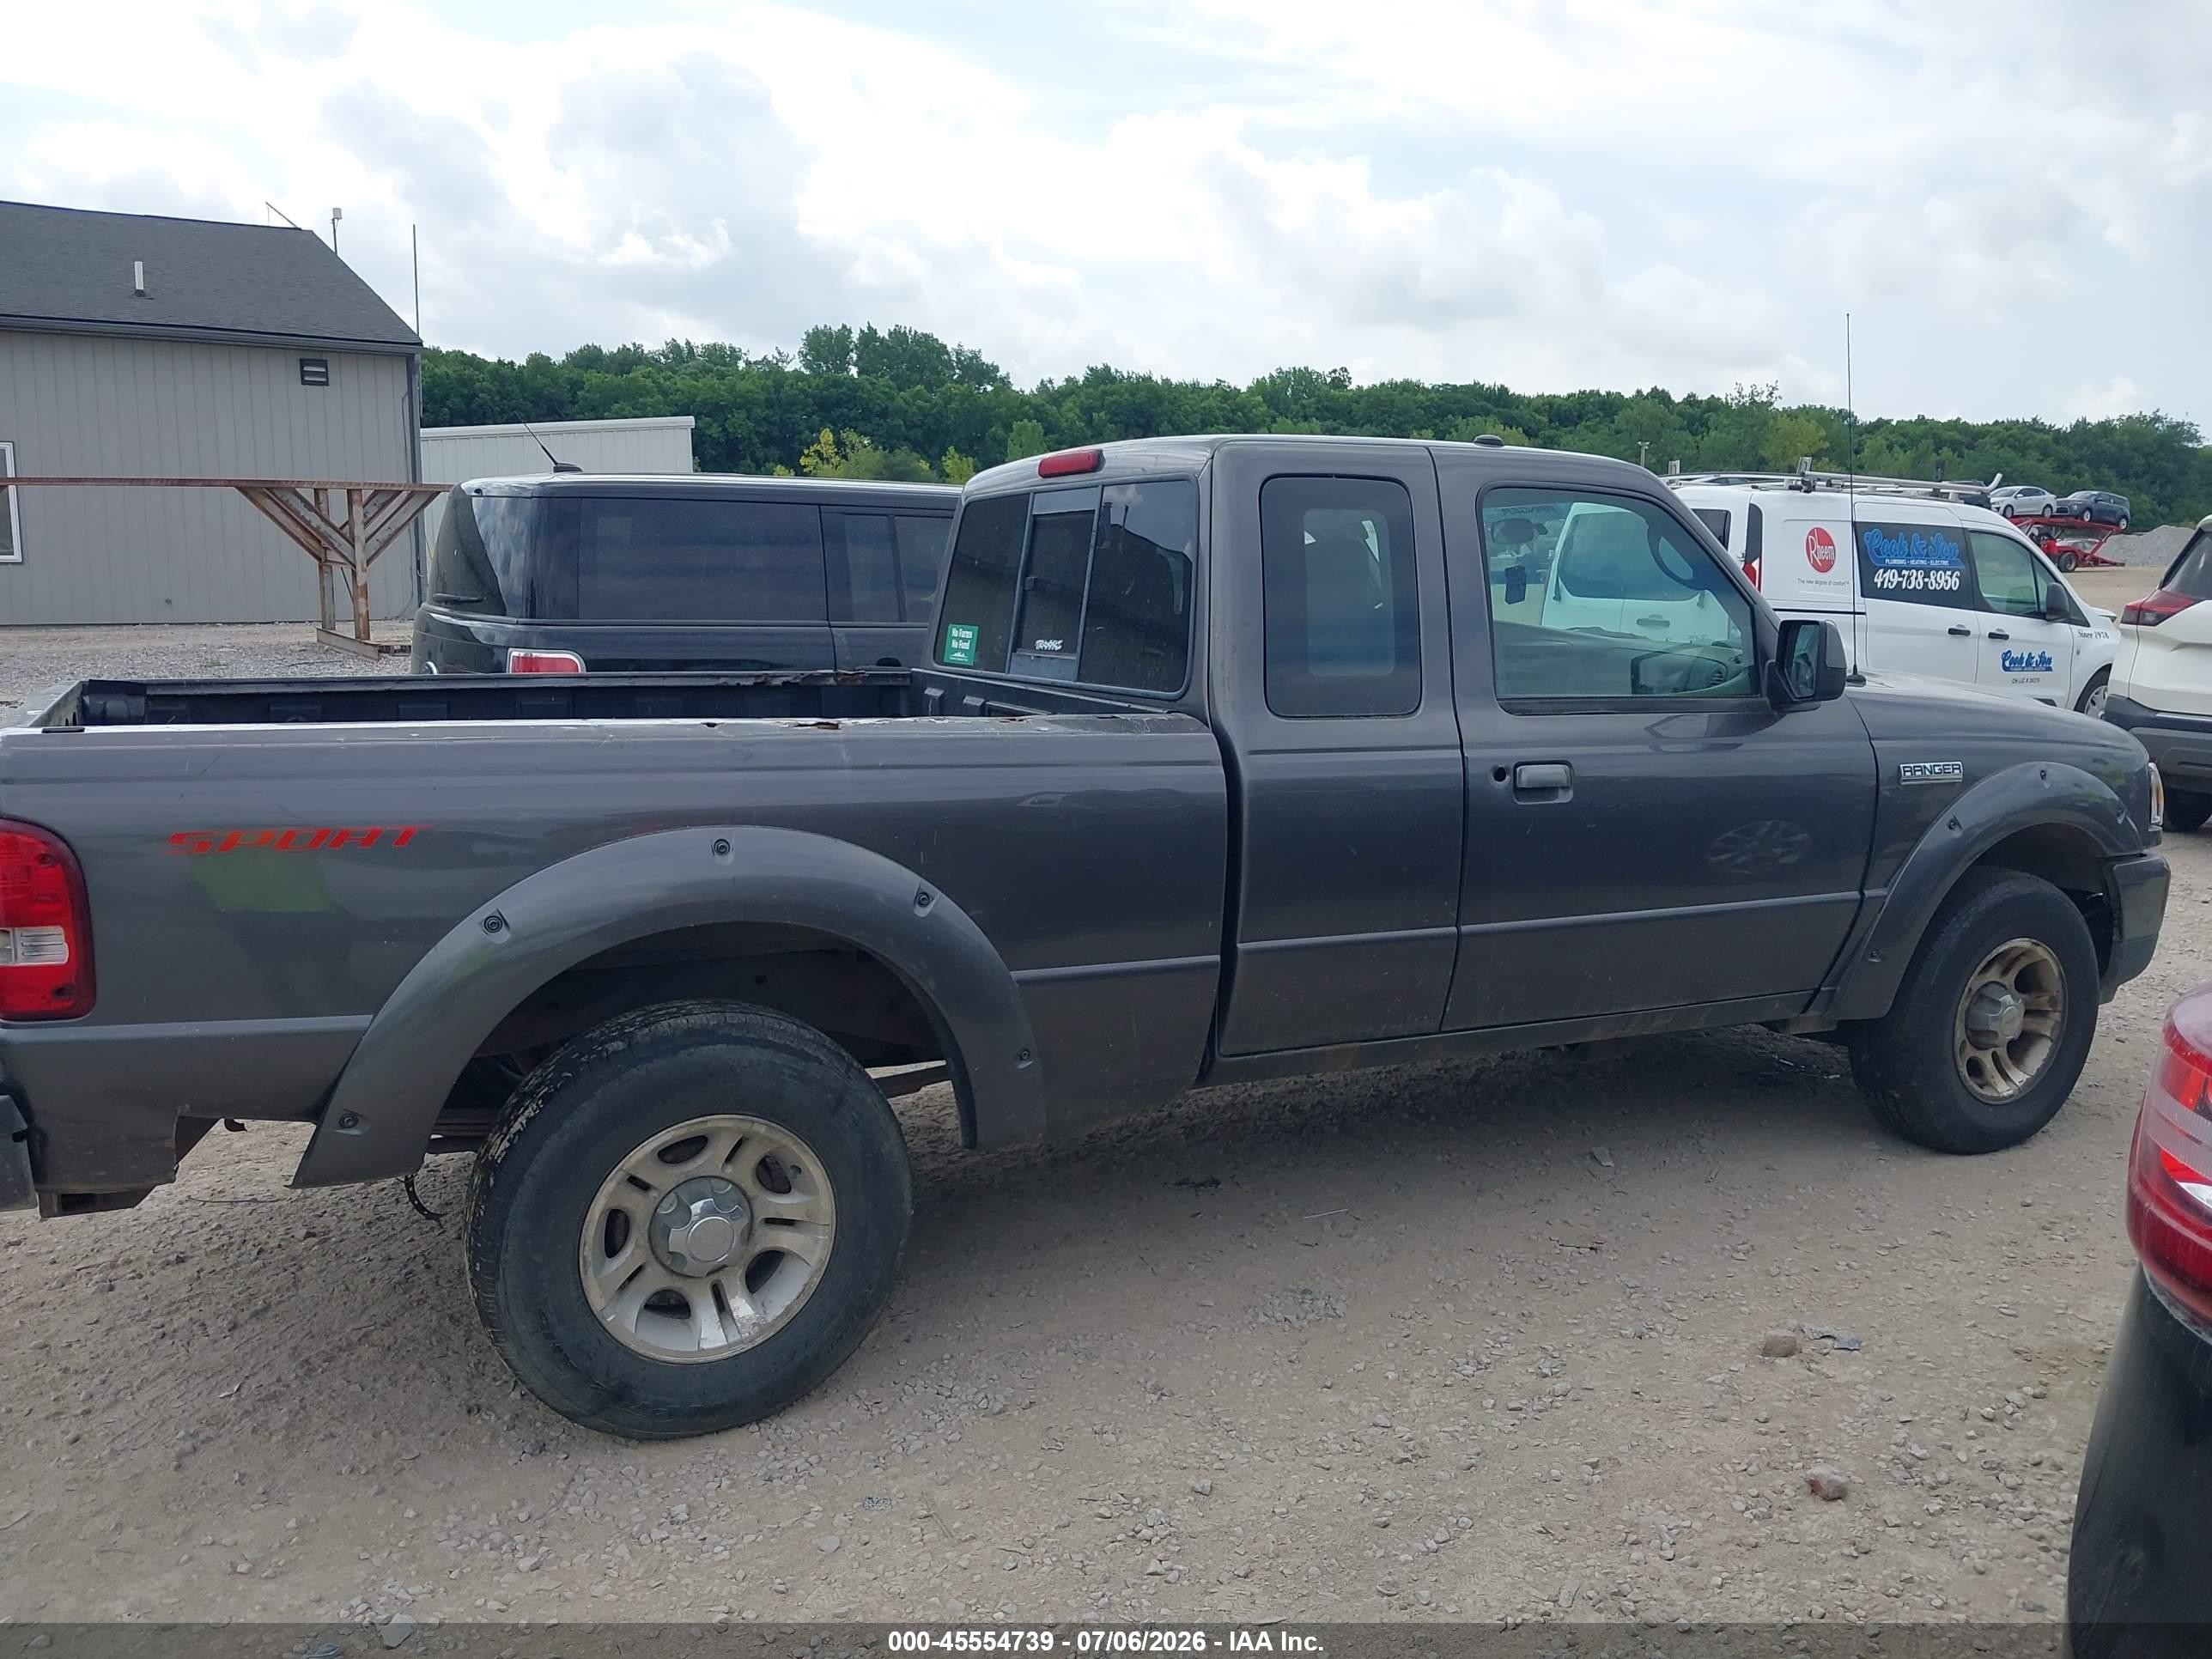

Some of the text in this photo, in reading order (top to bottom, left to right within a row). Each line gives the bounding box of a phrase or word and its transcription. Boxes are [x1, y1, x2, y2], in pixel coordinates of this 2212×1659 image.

[1808, 528, 1835, 567] Rheem
[1863, 529, 1959, 559] Cook & Son
[1874, 568, 1960, 591] 419-738-8956
[951, 628, 958, 638] No
[2077, 629, 2093, 639] Since
[951, 640, 958, 649] No
[2002, 649, 2025, 666] Cook
[1901, 763, 1961, 777] RANGER
[164, 824, 433, 856] SPORT
